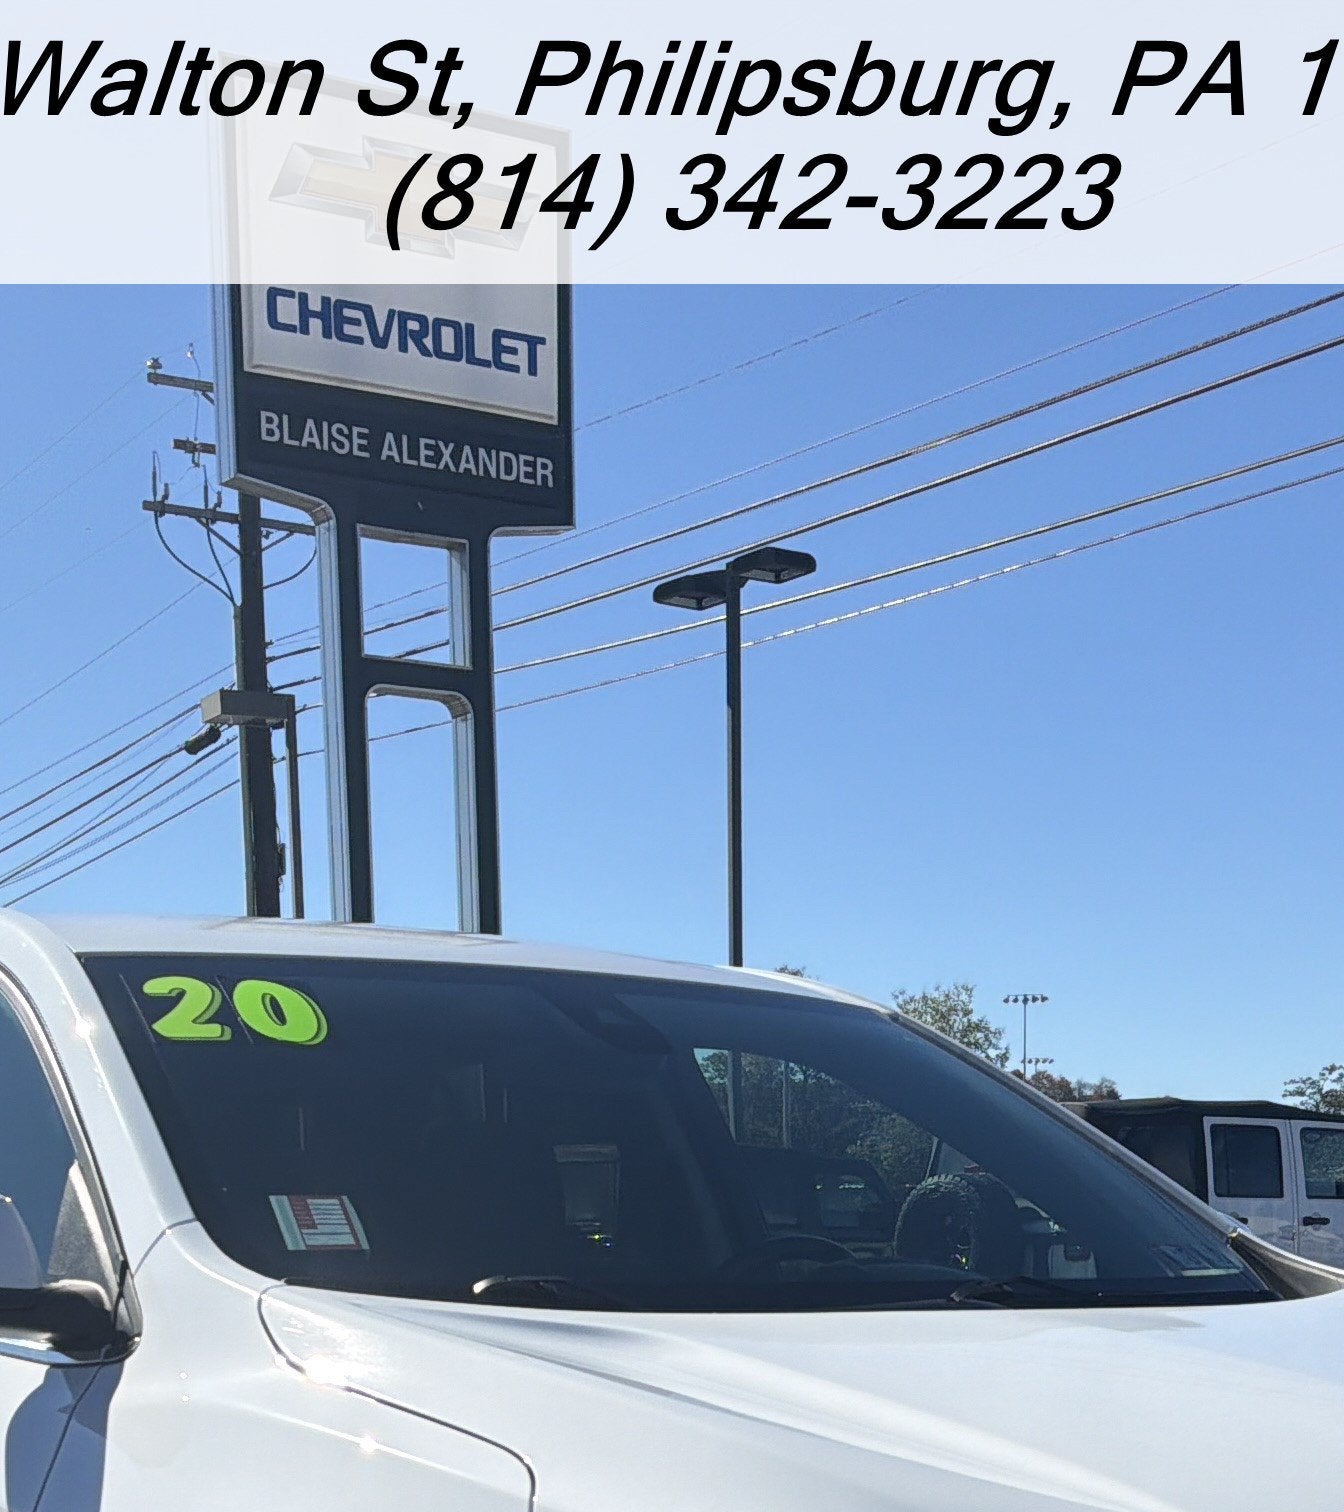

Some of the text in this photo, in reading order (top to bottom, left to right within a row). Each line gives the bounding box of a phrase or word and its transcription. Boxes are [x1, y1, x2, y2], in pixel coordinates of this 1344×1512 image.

[266, 286, 547, 377] CHEVROLET
[259, 410, 555, 488] BLAISE ALEXANDER
[142, 975, 329, 1046] 20
